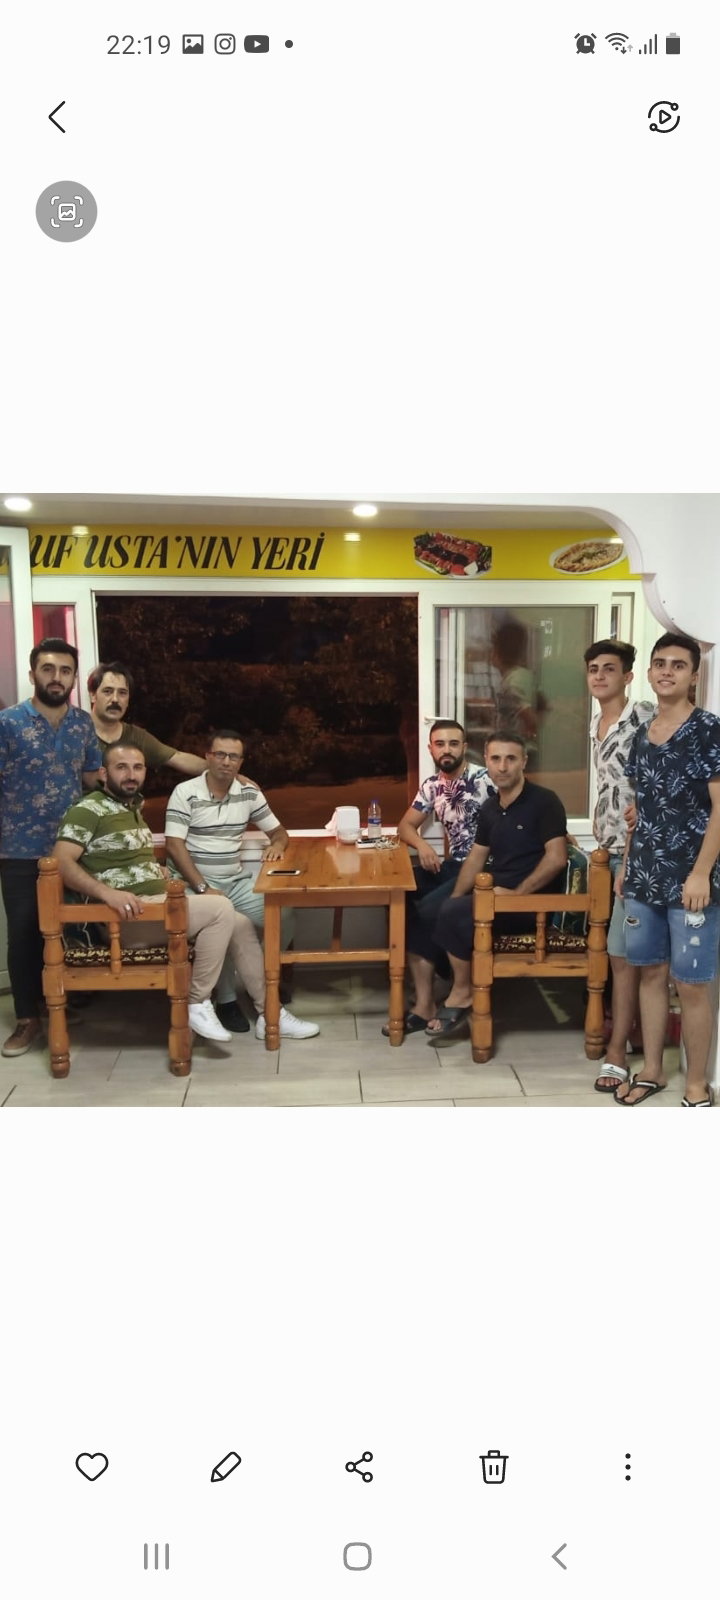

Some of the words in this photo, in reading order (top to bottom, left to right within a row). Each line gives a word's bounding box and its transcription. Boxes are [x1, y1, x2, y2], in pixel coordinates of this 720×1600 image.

[30, 534, 78, 569] UF
[84, 534, 242, 569] USTA'NIN
[250, 532, 325, 571] YERİ
